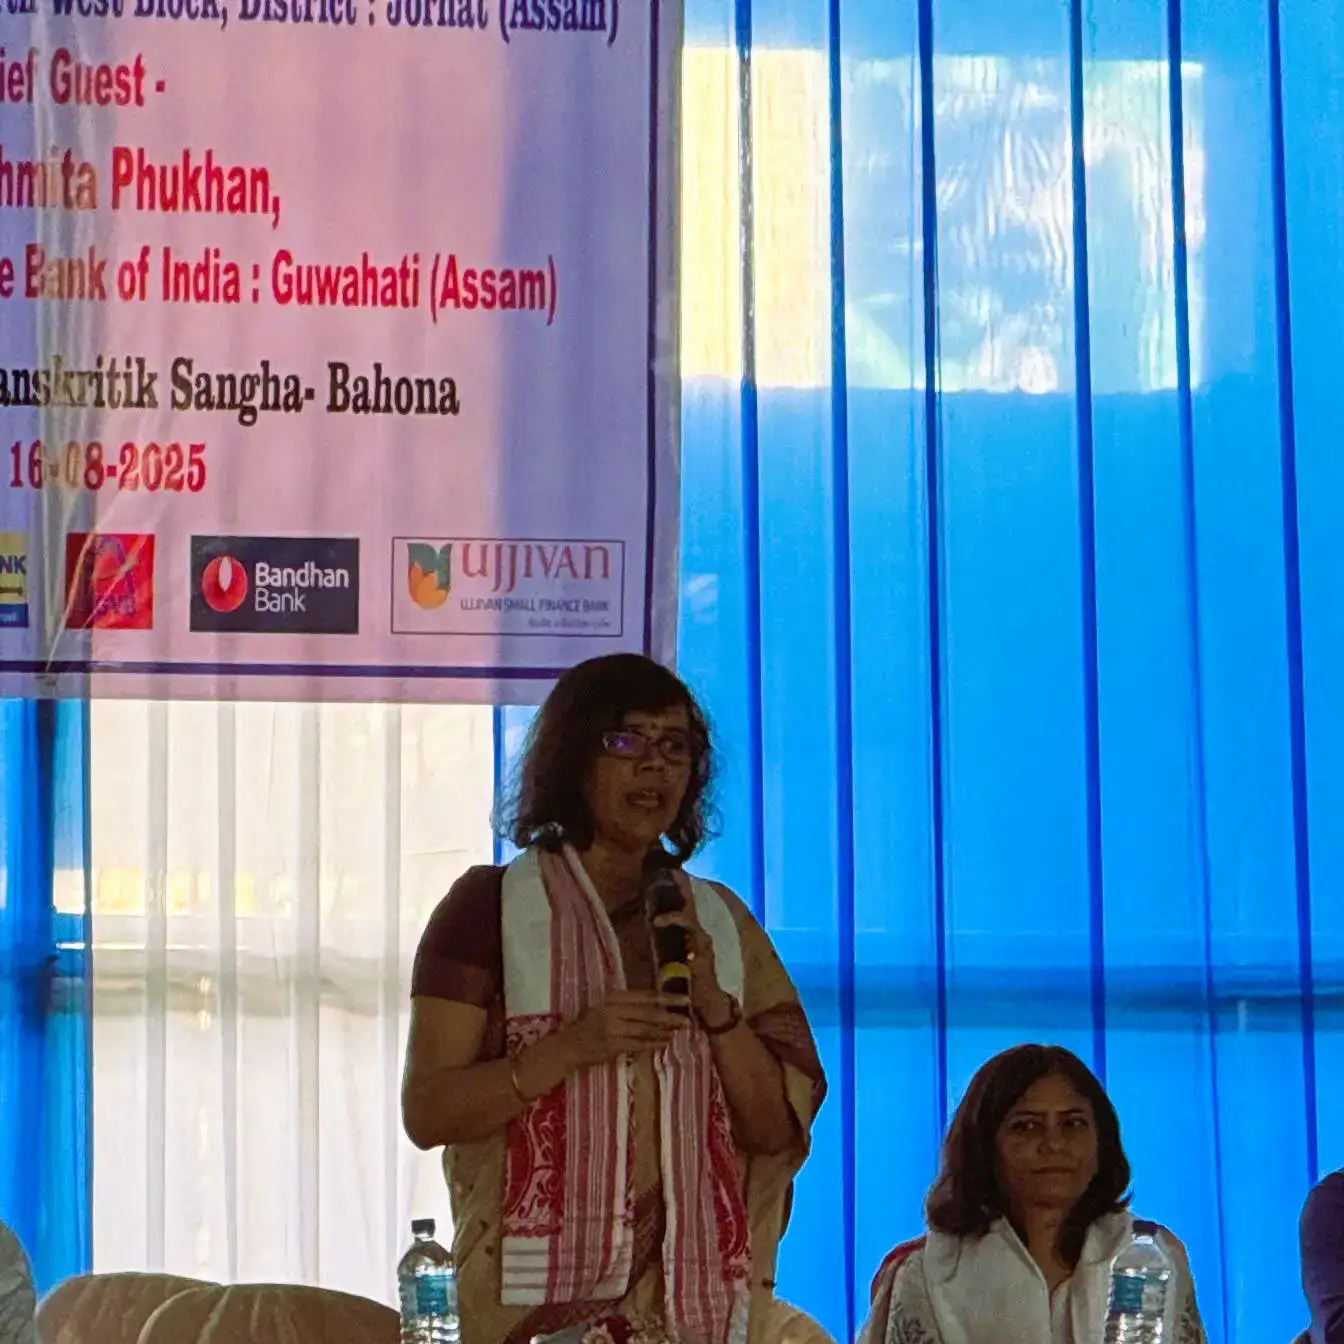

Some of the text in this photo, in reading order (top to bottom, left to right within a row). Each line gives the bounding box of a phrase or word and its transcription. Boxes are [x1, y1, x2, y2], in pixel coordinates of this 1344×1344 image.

[50, 47, 145, 107] Guest
[111, 146, 281, 230] Phukhan,
[25, 242, 108, 301] Bank
[117, 245, 150, 302] of
[162, 247, 242, 304] India
[271, 249, 420, 309] Guwahati
[430, 253, 557, 325] (Assam)
[170, 357, 315, 426] Sangha-
[327, 361, 460, 416] Bahona
[10, 440, 207, 494] 16-08-2025
[255, 561, 350, 589] Bandhan
[461, 543, 611, 594] UJJIVAN
[255, 587, 306, 613] Bank
